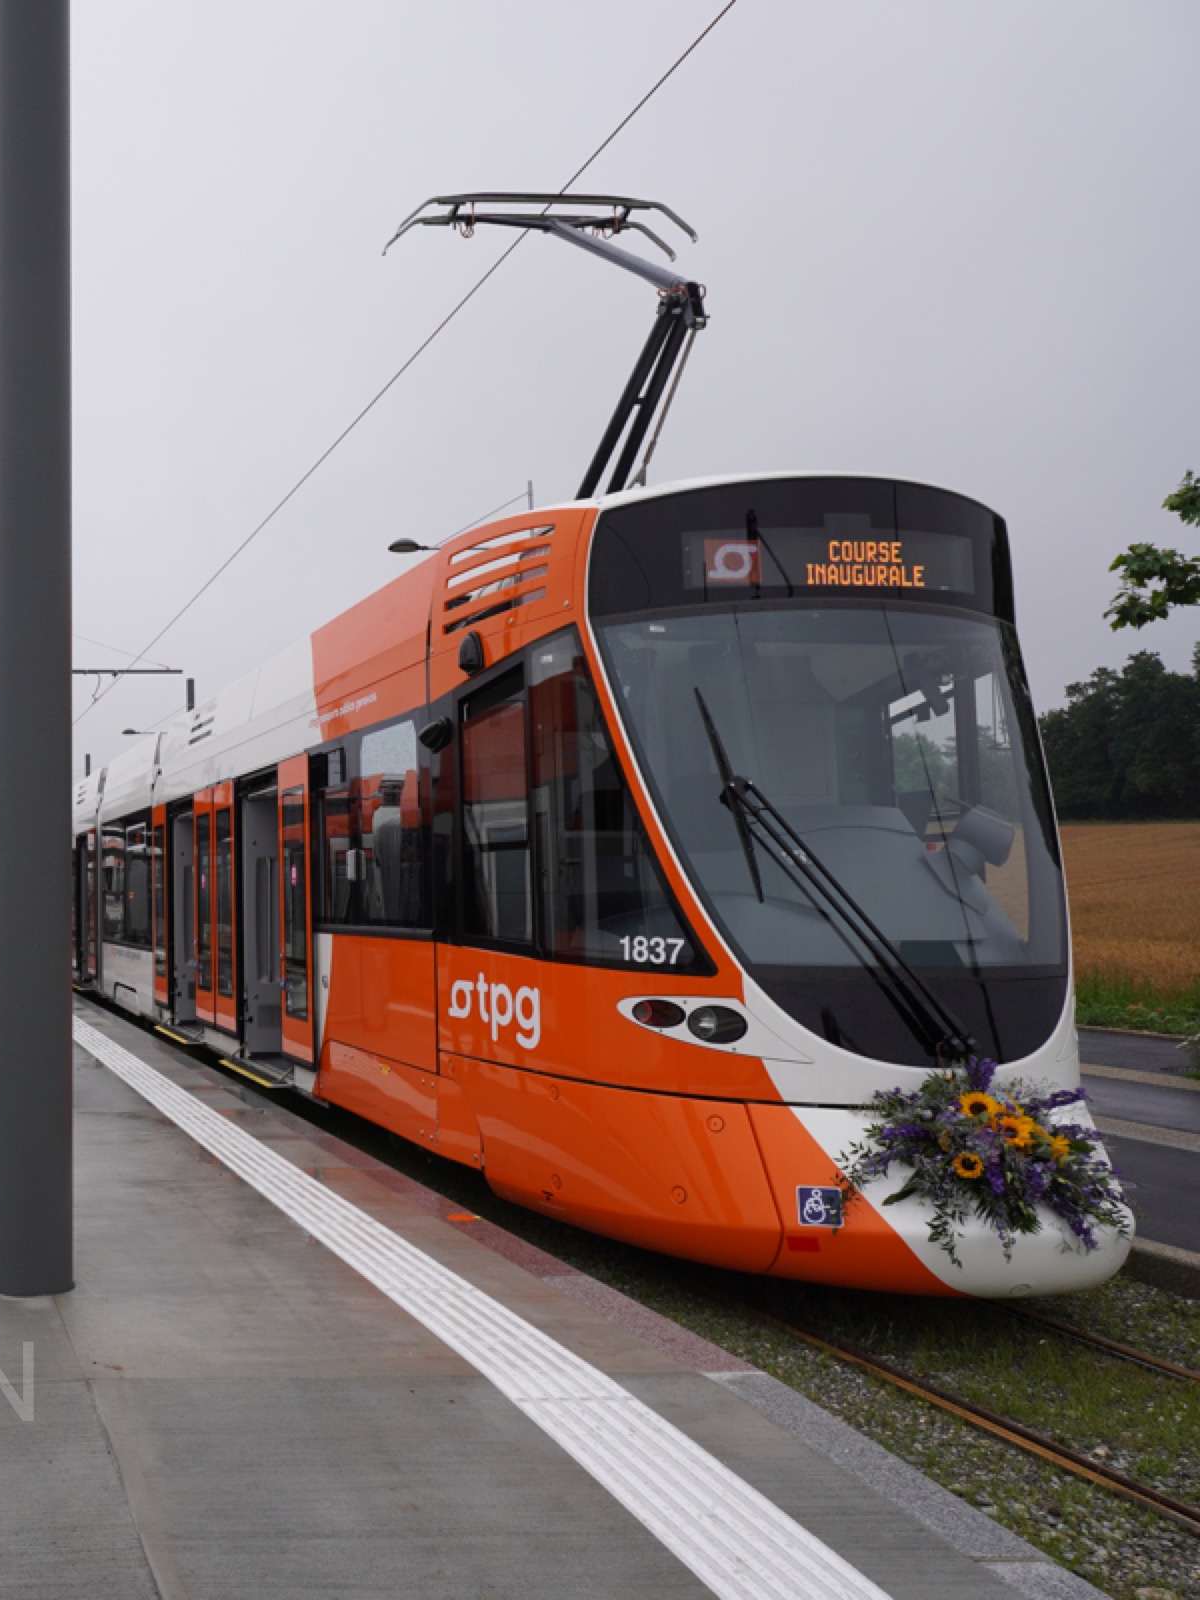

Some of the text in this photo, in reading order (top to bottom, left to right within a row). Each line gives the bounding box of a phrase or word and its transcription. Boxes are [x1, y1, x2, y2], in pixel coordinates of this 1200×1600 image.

[828, 540, 902, 563] COURSE
[805, 563, 925, 587] INAUGURALE
[619, 936, 685, 965] 1837
